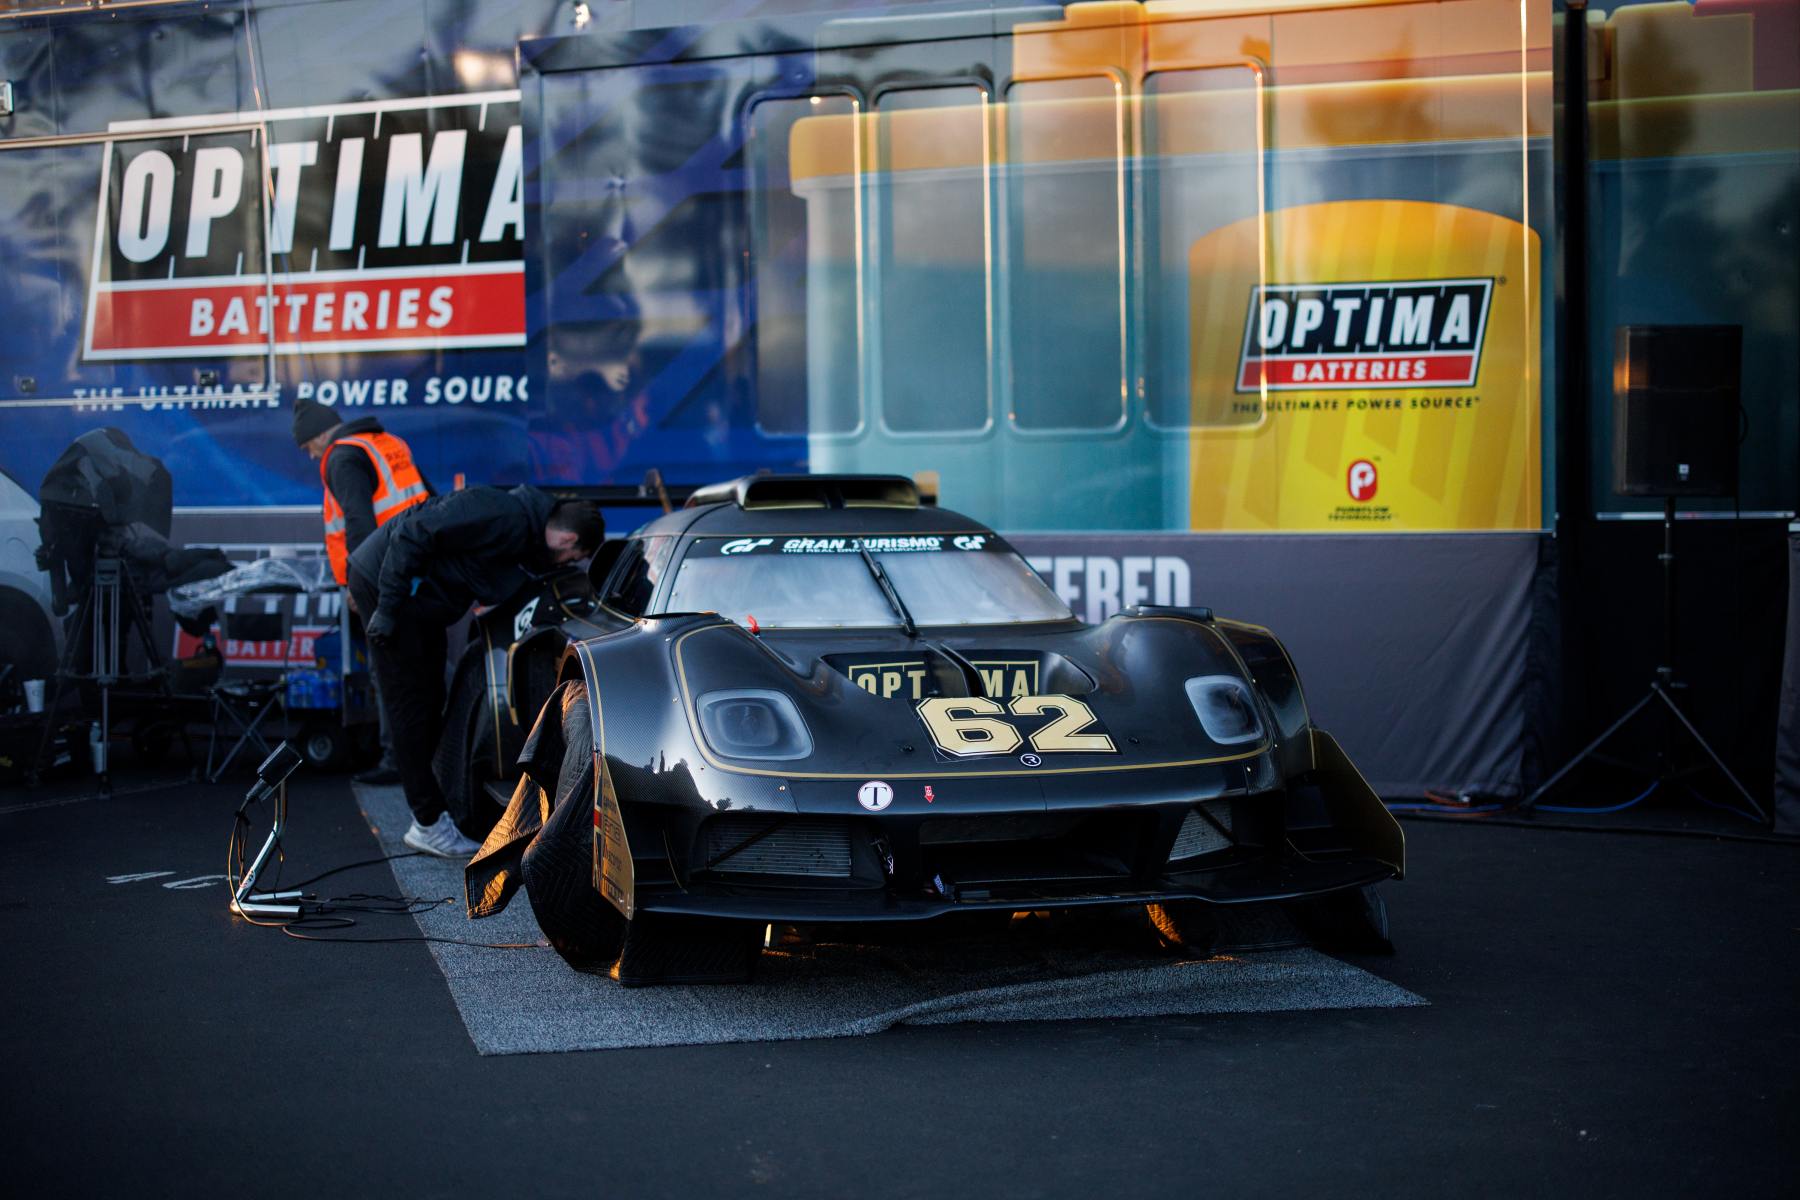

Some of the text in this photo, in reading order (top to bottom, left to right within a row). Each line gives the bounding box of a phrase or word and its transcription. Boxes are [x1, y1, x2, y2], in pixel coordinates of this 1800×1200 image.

[118, 125, 524, 263] OPTIMA
[189, 286, 454, 338] BATTERIES
[1257, 294, 1471, 349] OPTIMA
[1292, 360, 1427, 381] BATTERIES
[73, 387, 124, 411] THE
[139, 383, 281, 411] ULTIMATE
[297, 378, 409, 407] POWER
[1232, 401, 1258, 414] THE
[1266, 399, 1339, 412] ULTIMATE
[1347, 398, 1402, 411] POWER
[783, 538, 846, 550] GRAN
[857, 669, 1030, 699] OPTMA
[915, 695, 1118, 757] 62
